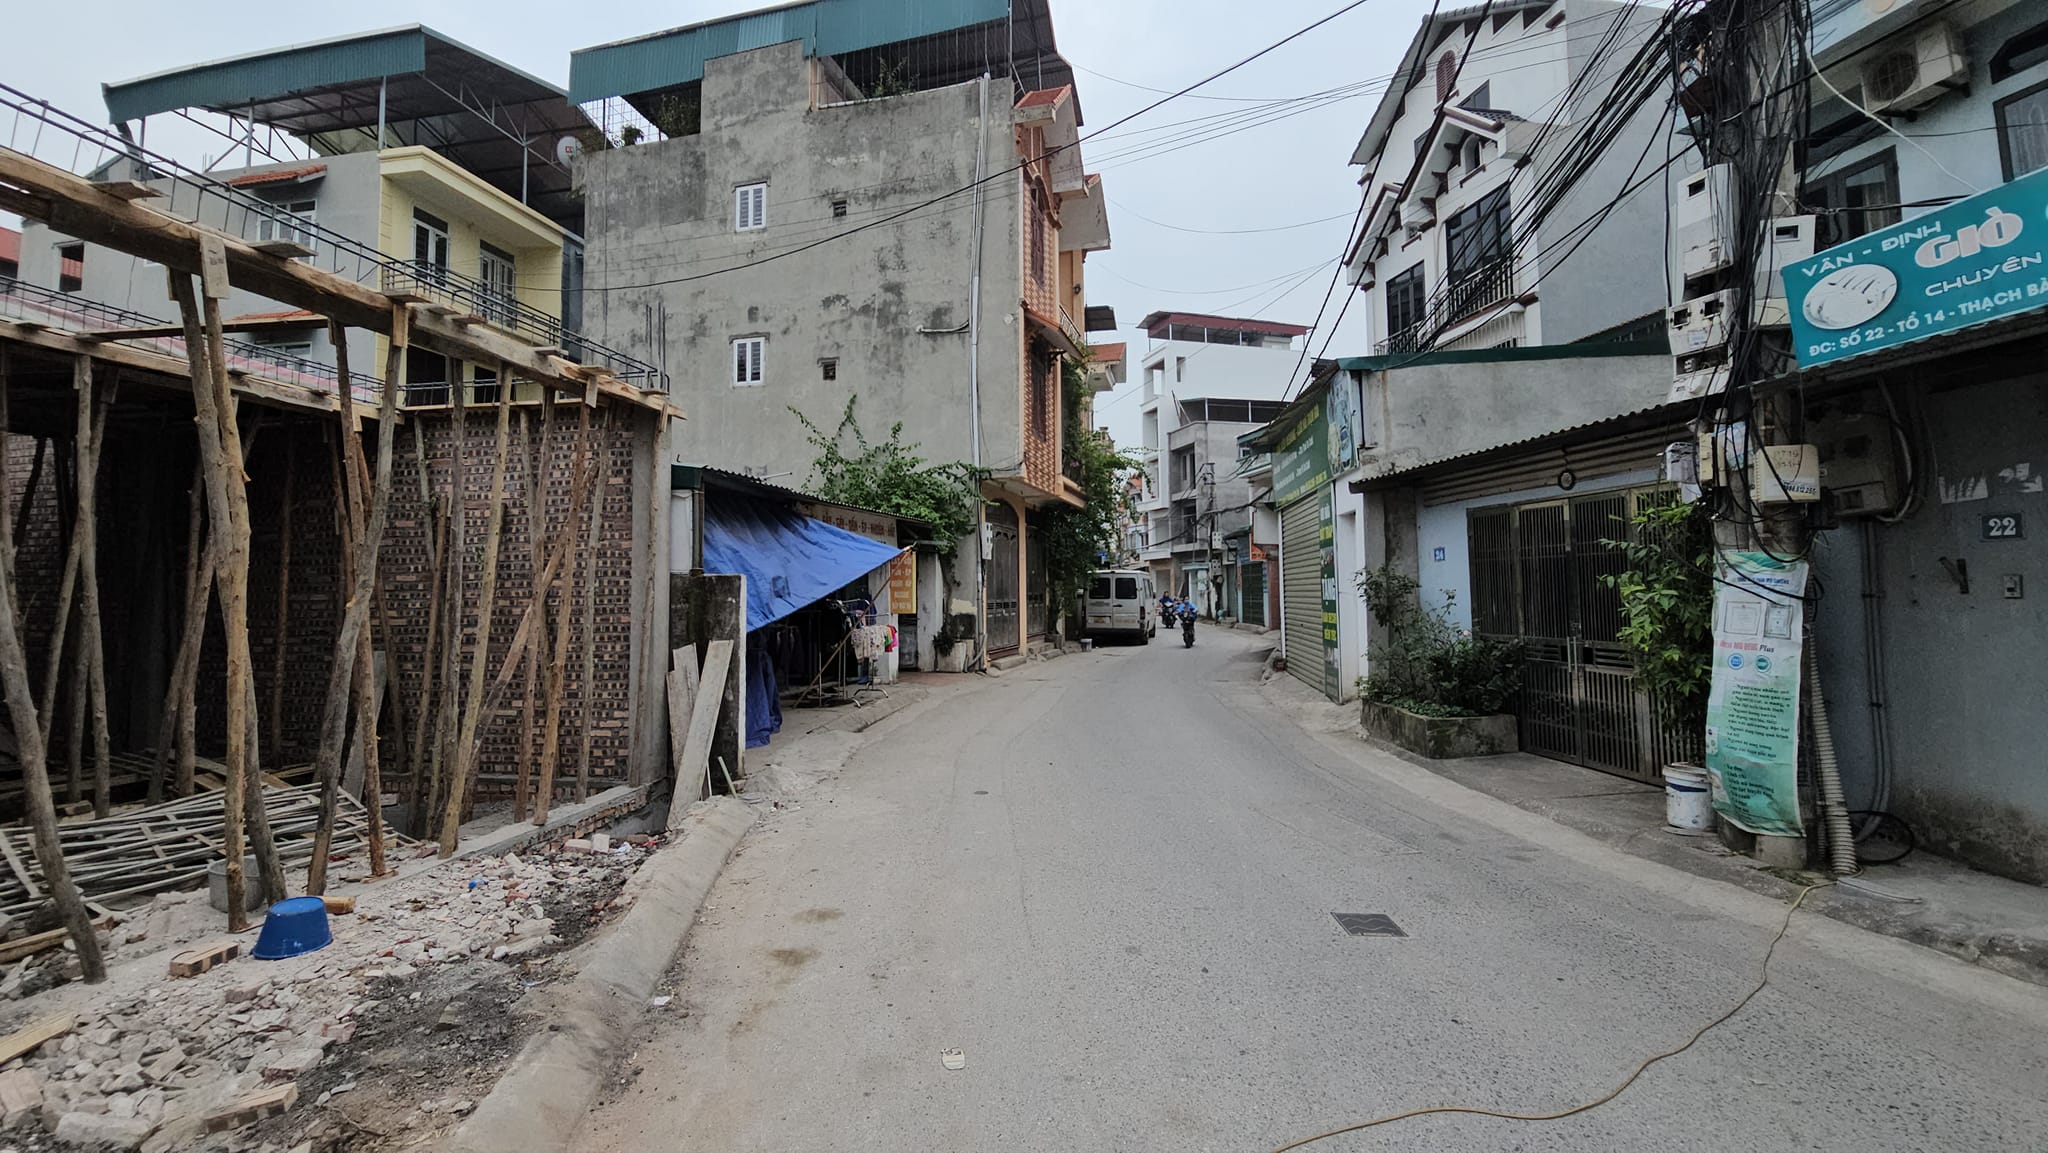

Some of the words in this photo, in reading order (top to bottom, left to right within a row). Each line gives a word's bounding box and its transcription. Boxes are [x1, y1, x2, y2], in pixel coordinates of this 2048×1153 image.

[1881, 221, 1941, 250] ĐỊNH
[1914, 206, 2024, 268] GIÒ
[1925, 252, 2042, 297] CHUYÊN
[1809, 341, 1836, 357] ĐC:
[1840, 330, 1861, 349] SỐ
[1865, 328, 1885, 343] 22
[1896, 311, 1919, 333] TỔ
[1924, 310, 1945, 325] 14
[1959, 284, 2022, 317] THẠCH
[1988, 516, 2017, 537] 22
[1759, 644, 1775, 653] Plus
